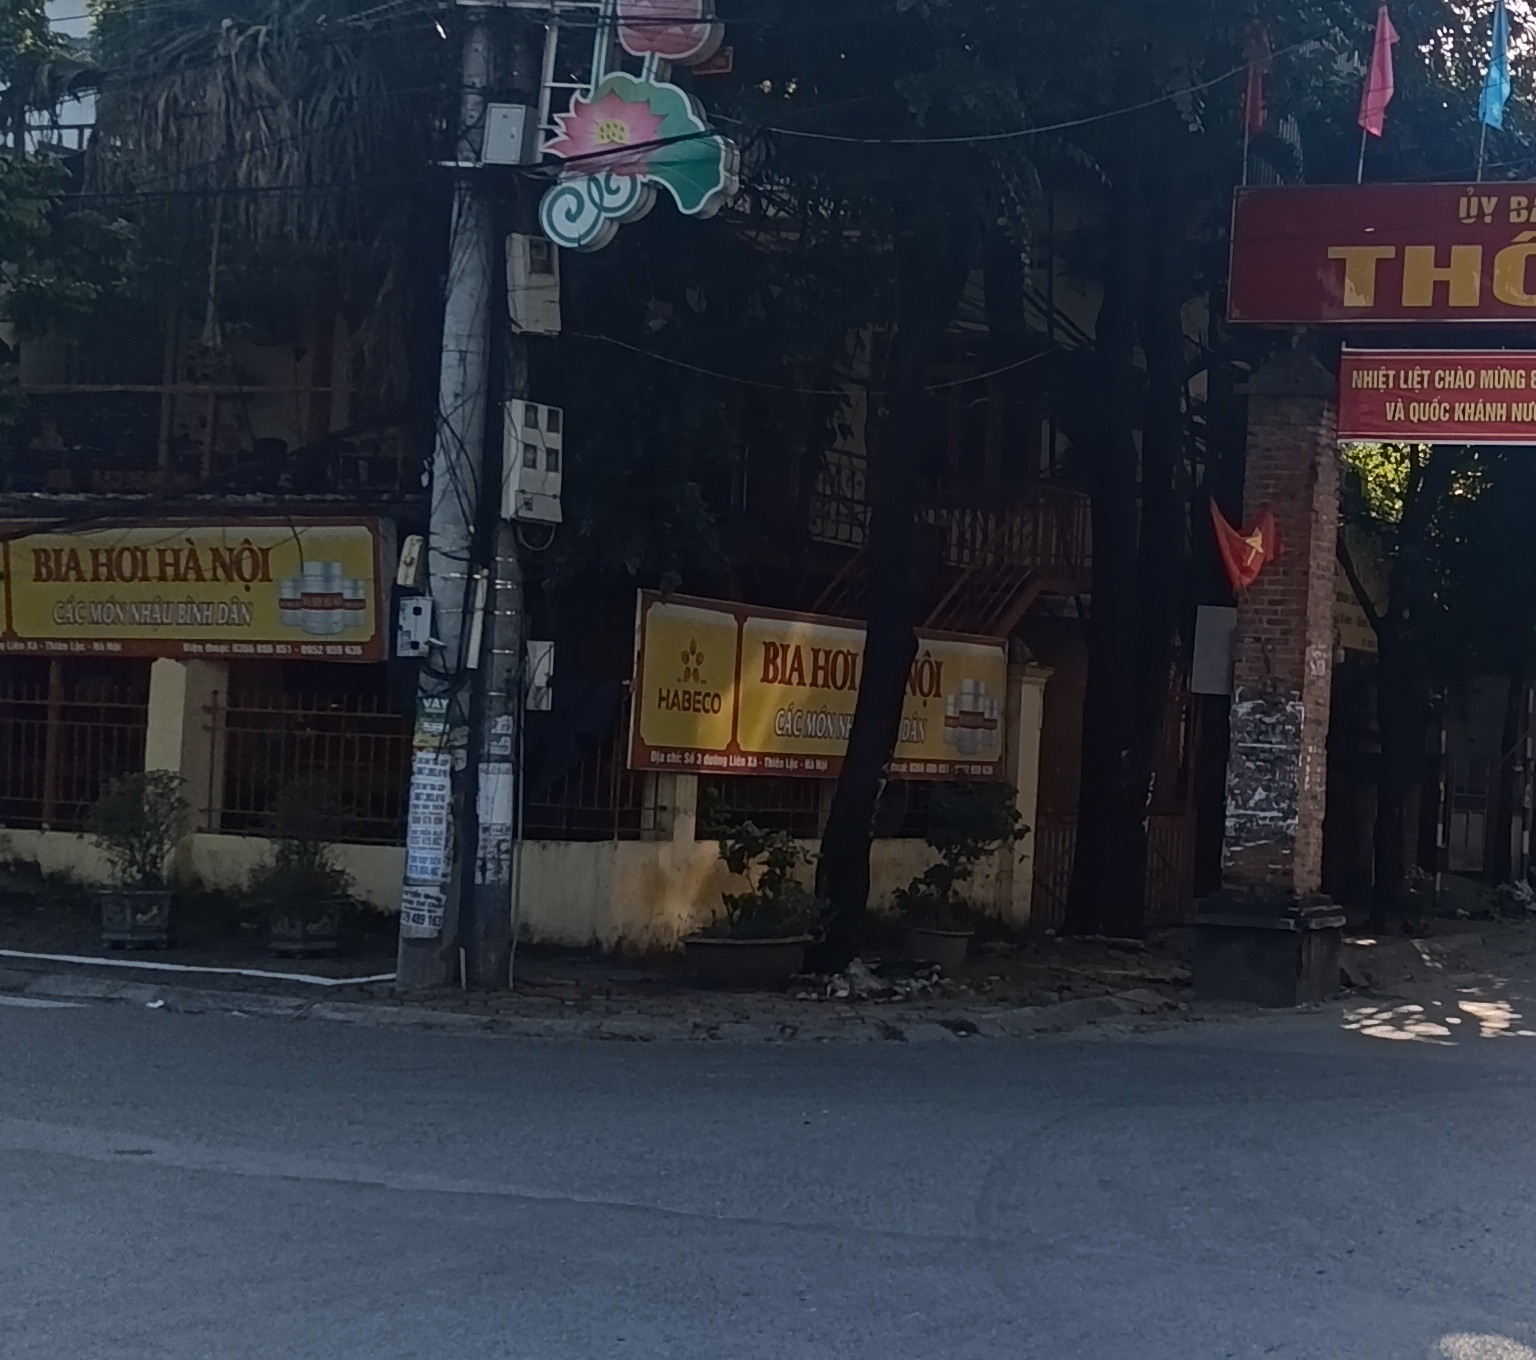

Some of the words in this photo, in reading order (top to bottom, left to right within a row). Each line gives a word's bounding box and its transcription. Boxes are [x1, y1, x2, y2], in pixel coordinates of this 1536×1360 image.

[1459, 187, 1498, 224] ỦY
[1352, 365, 1396, 393] NHIỆT
[1399, 365, 1430, 393] LIỆT
[1434, 365, 1475, 389] CHÀO
[1479, 365, 1526, 389] MỪNG
[1386, 398, 1405, 422] VÀ
[1409, 395, 1450, 424] QUỐC
[1454, 397, 1507, 422] KHÁNH
[33, 547, 87, 582] BIA
[89, 546, 153, 582] HƠI
[158, 537, 206, 582] HÀ
[209, 538, 274, 592] NỘI
[53, 596, 85, 625] CÁC
[90, 596, 125, 625] MÓN
[129, 596, 172, 631] NHẬU
[177, 596, 214, 626] BÌNH
[217, 596, 254, 626] DÂN
[761, 641, 806, 687] BIA
[809, 648, 859, 692] HƠI
[422, 697, 449, 709] VAY
[657, 688, 722, 715] HABECO
[774, 705, 803, 738] CÁC
[803, 705, 836, 740] MÓN
